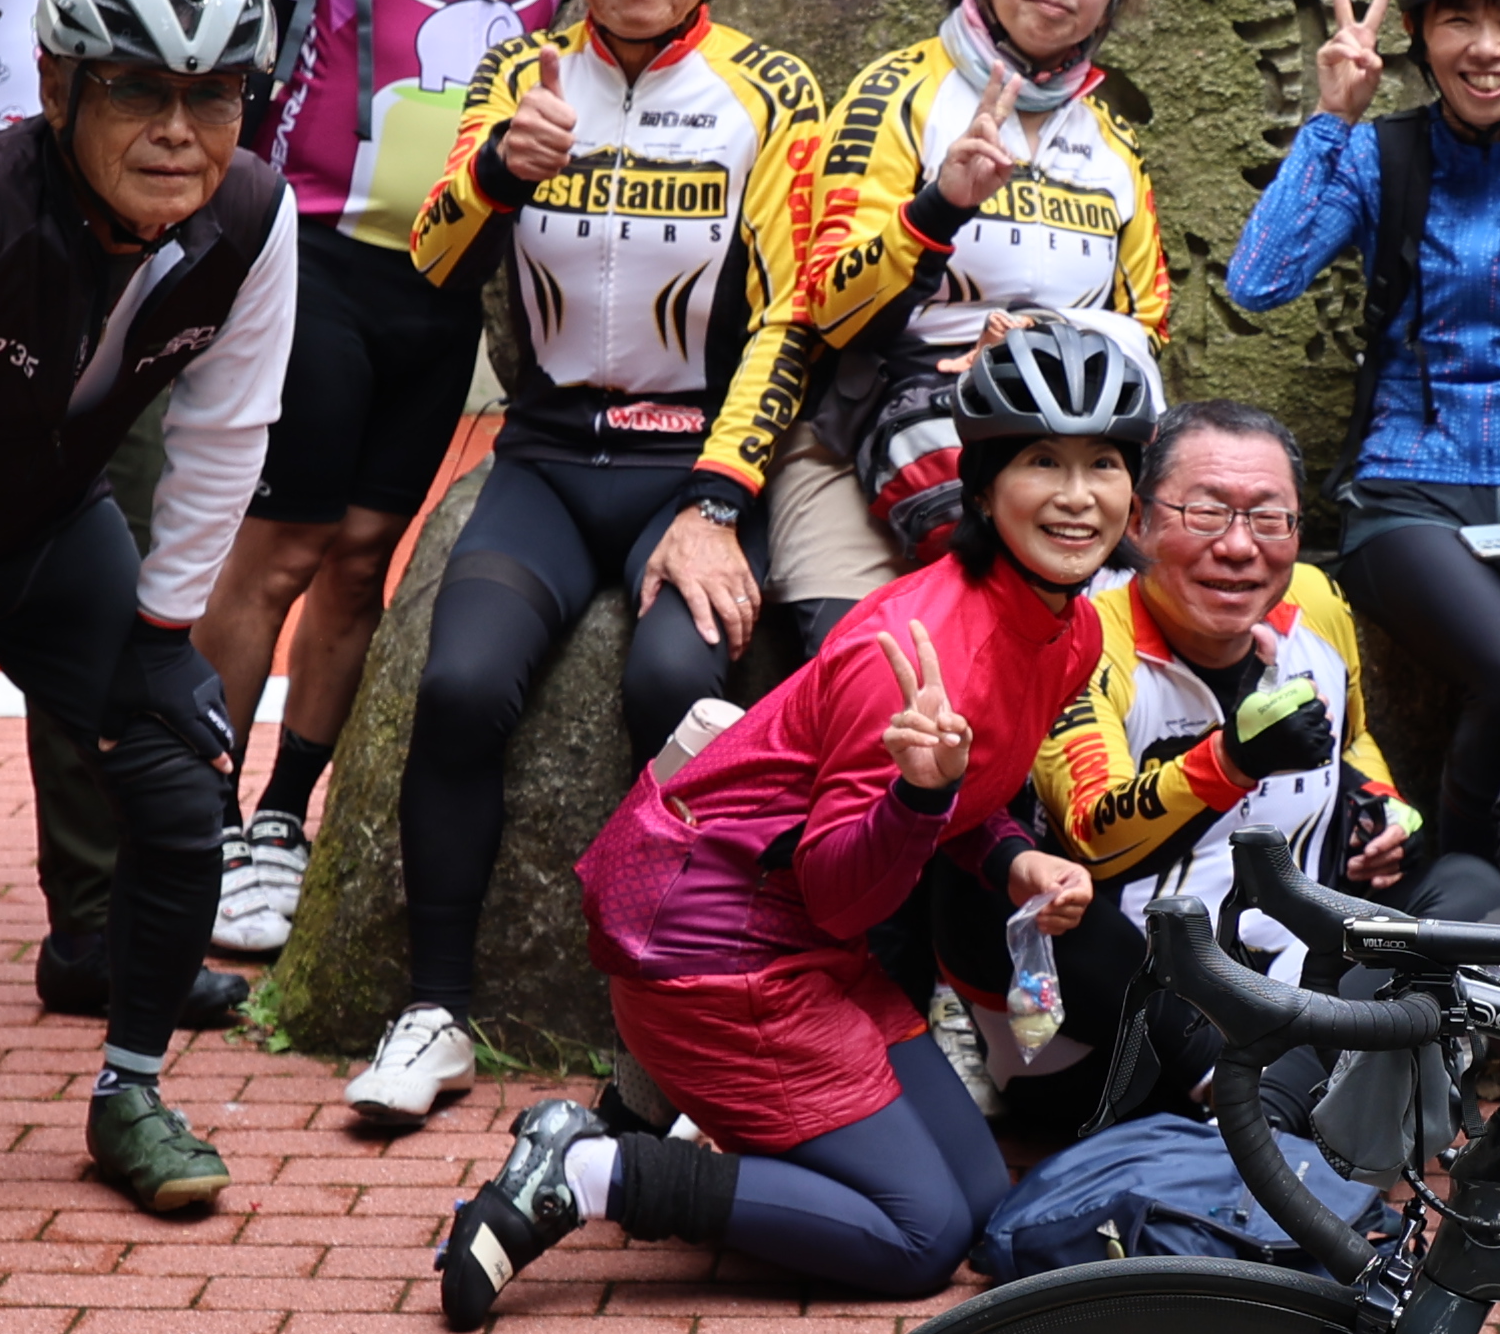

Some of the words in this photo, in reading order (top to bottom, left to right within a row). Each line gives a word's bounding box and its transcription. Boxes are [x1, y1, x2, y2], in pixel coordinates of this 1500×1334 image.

[533, 175, 586, 209] est
[591, 170, 724, 214] Station
[1017, 184, 1122, 234] Station
[539, 214, 723, 244] IDERS
[973, 227, 1114, 264] IDERS
[605, 405, 706, 434] WINDY
